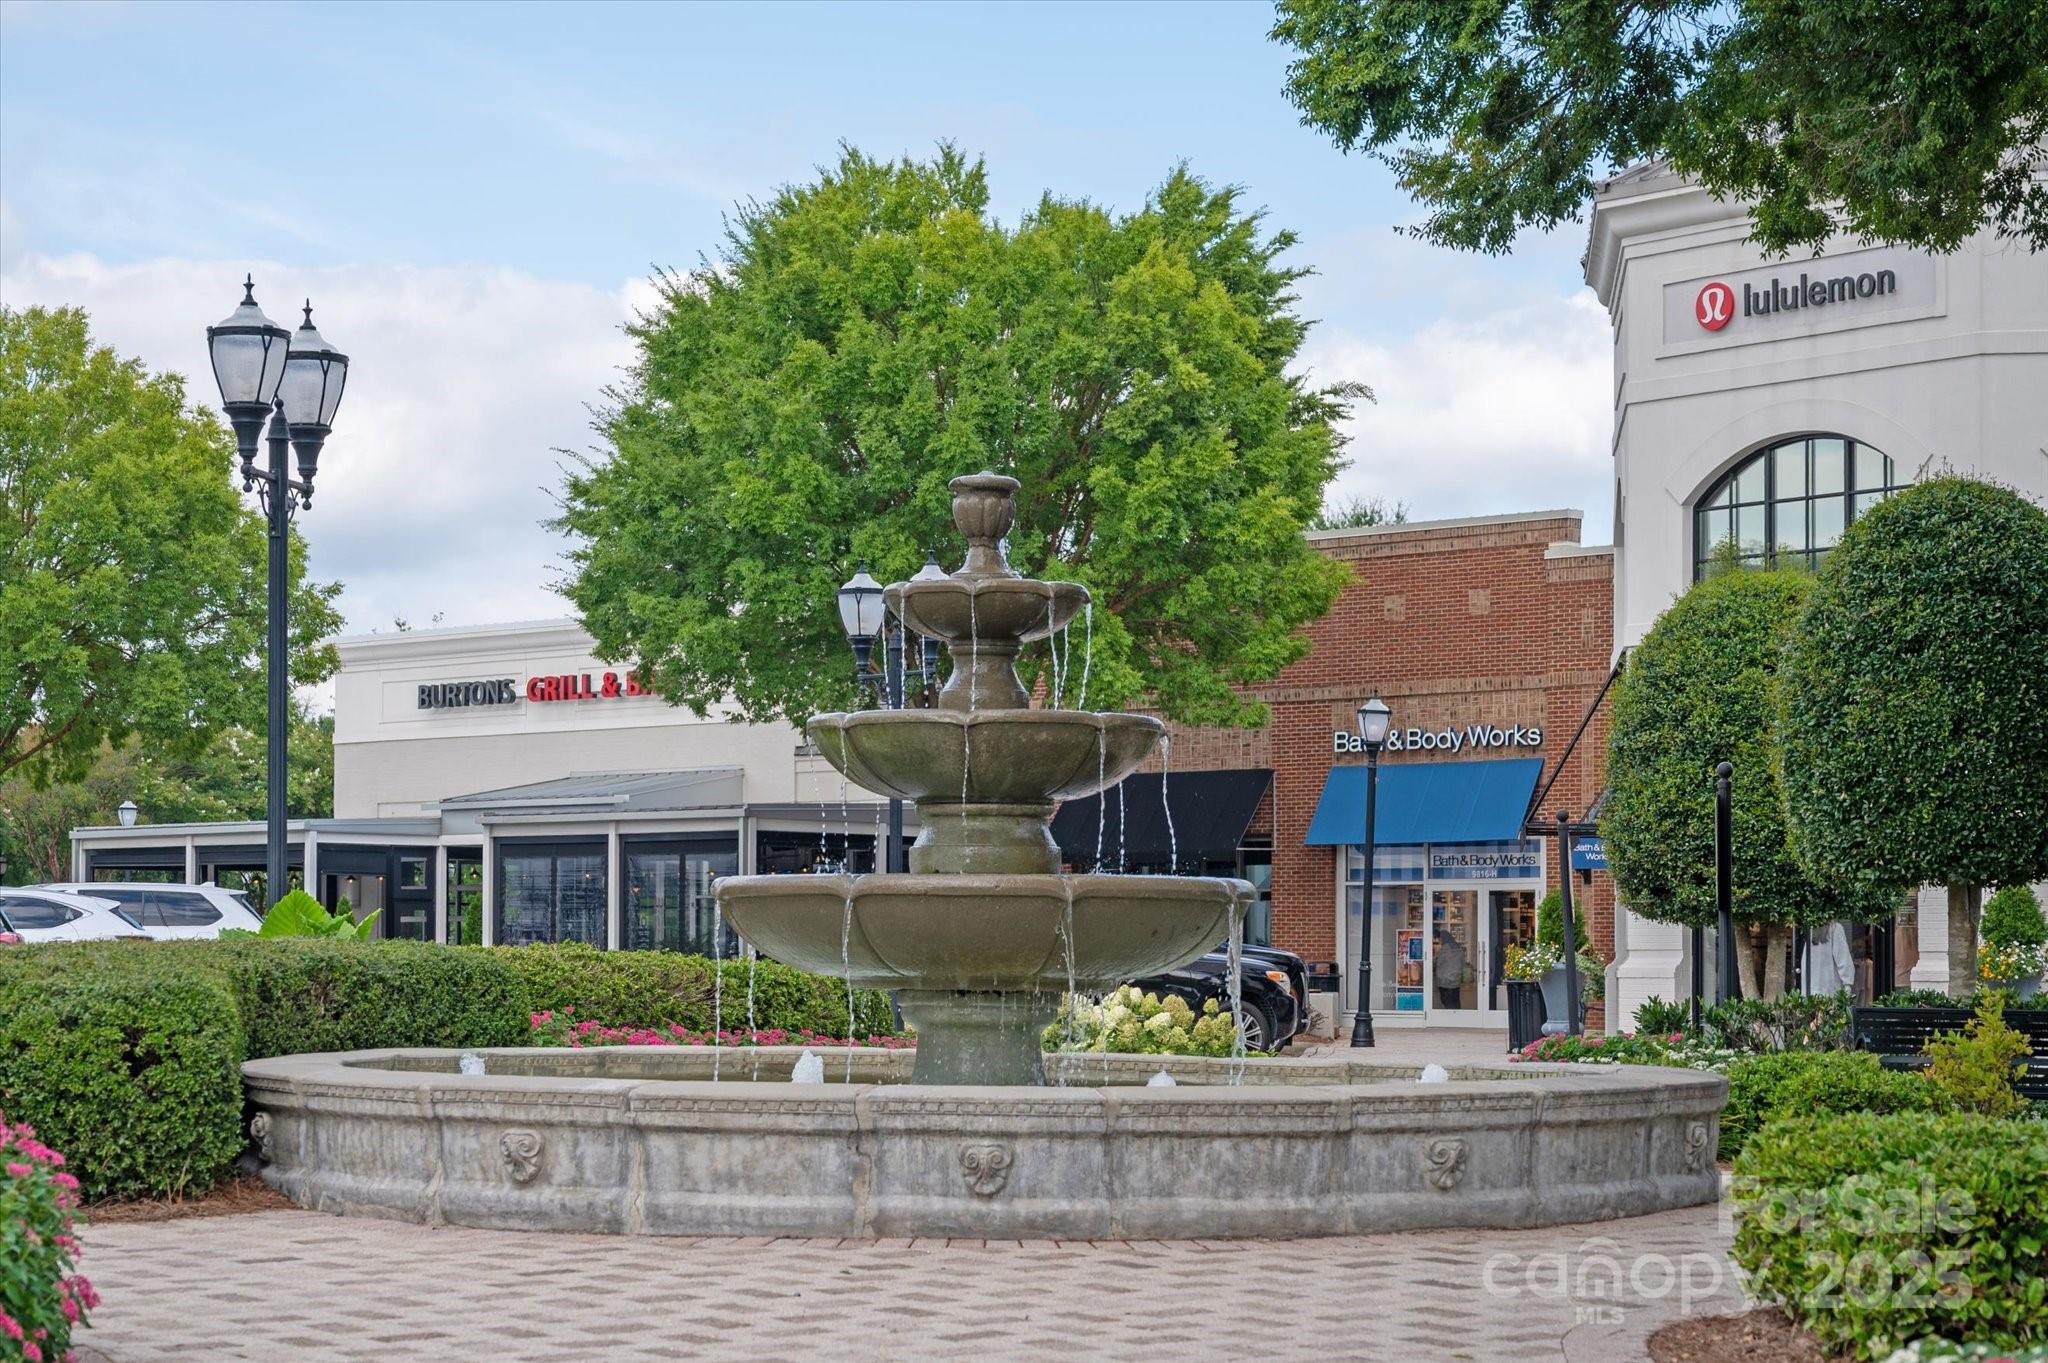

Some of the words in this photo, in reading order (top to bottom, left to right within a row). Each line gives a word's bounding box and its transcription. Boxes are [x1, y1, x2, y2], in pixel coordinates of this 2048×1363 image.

[1743, 267, 1896, 318] lululemon
[417, 678, 517, 709] BURTONS
[526, 673, 597, 703] GRILL
[601, 671, 622, 699] &
[1333, 731, 1383, 753] Ba
[1387, 729, 1402, 751] &
[1406, 727, 1468, 753] Body
[1467, 723, 1543, 748] Works
[1432, 855, 1459, 867] Bath
[1459, 855, 1469, 866] &
[1469, 854, 1500, 868] Body
[1499, 853, 1537, 866] Works
